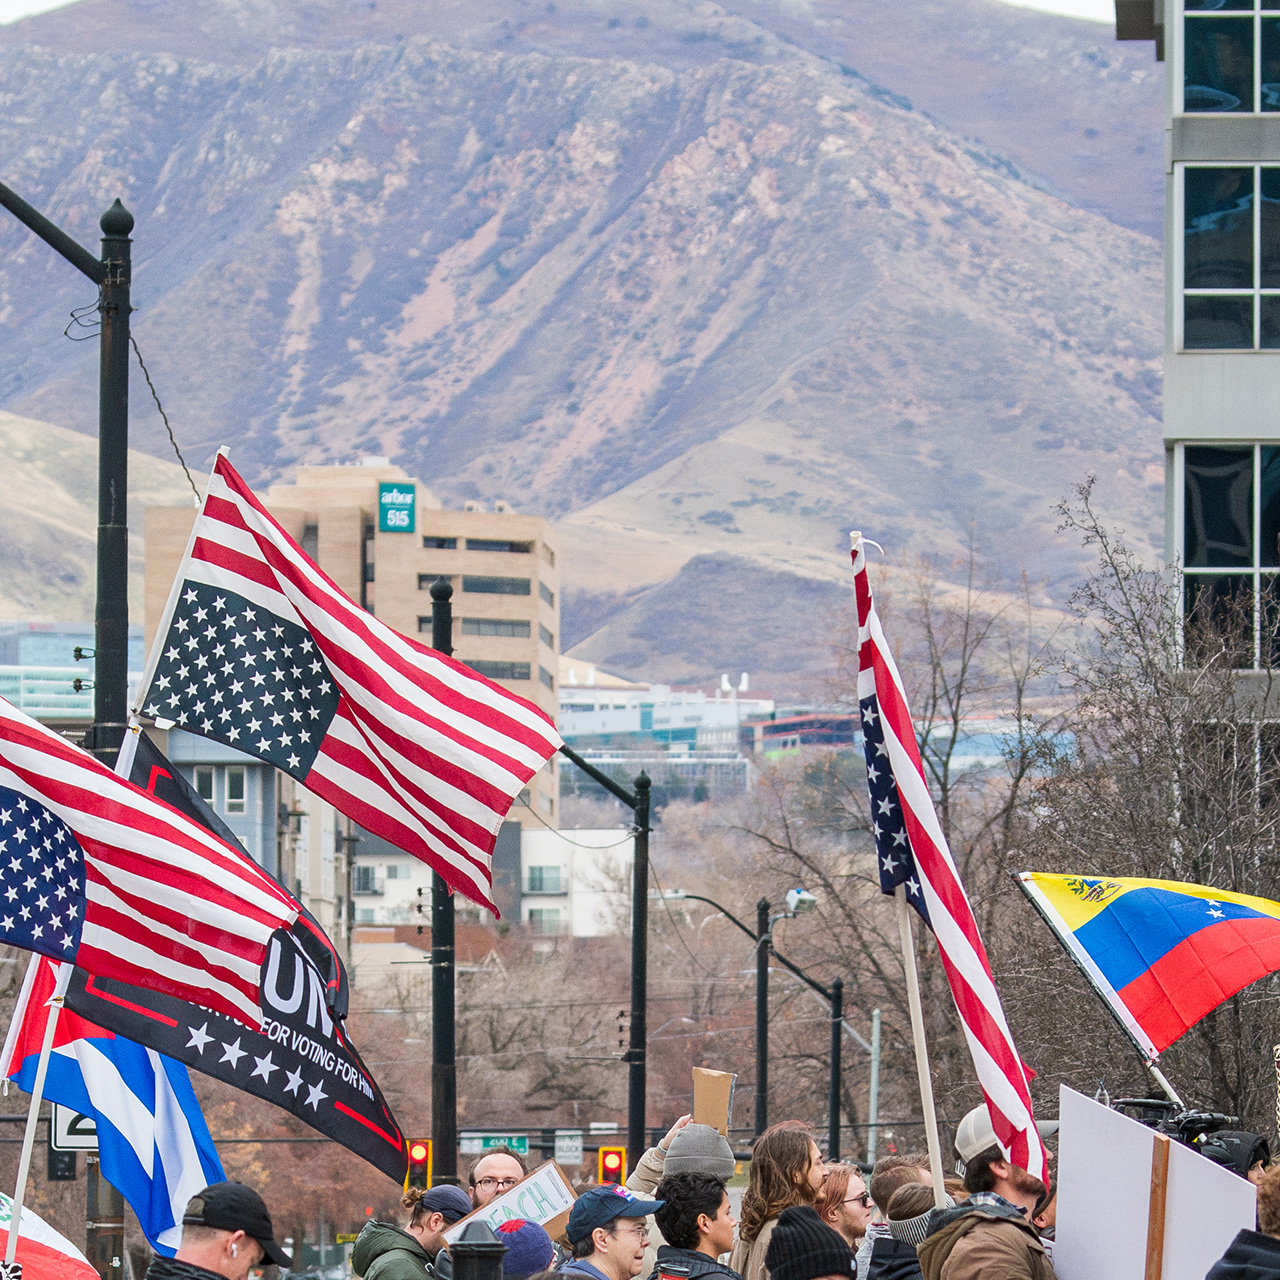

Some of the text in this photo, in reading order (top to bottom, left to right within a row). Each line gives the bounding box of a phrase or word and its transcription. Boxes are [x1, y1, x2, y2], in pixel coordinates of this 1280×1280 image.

[387, 510, 410, 527] 515
[260, 1016, 290, 1046] FOR
[291, 1030, 336, 1072] VOTING
[335, 1058, 359, 1089] FOR
